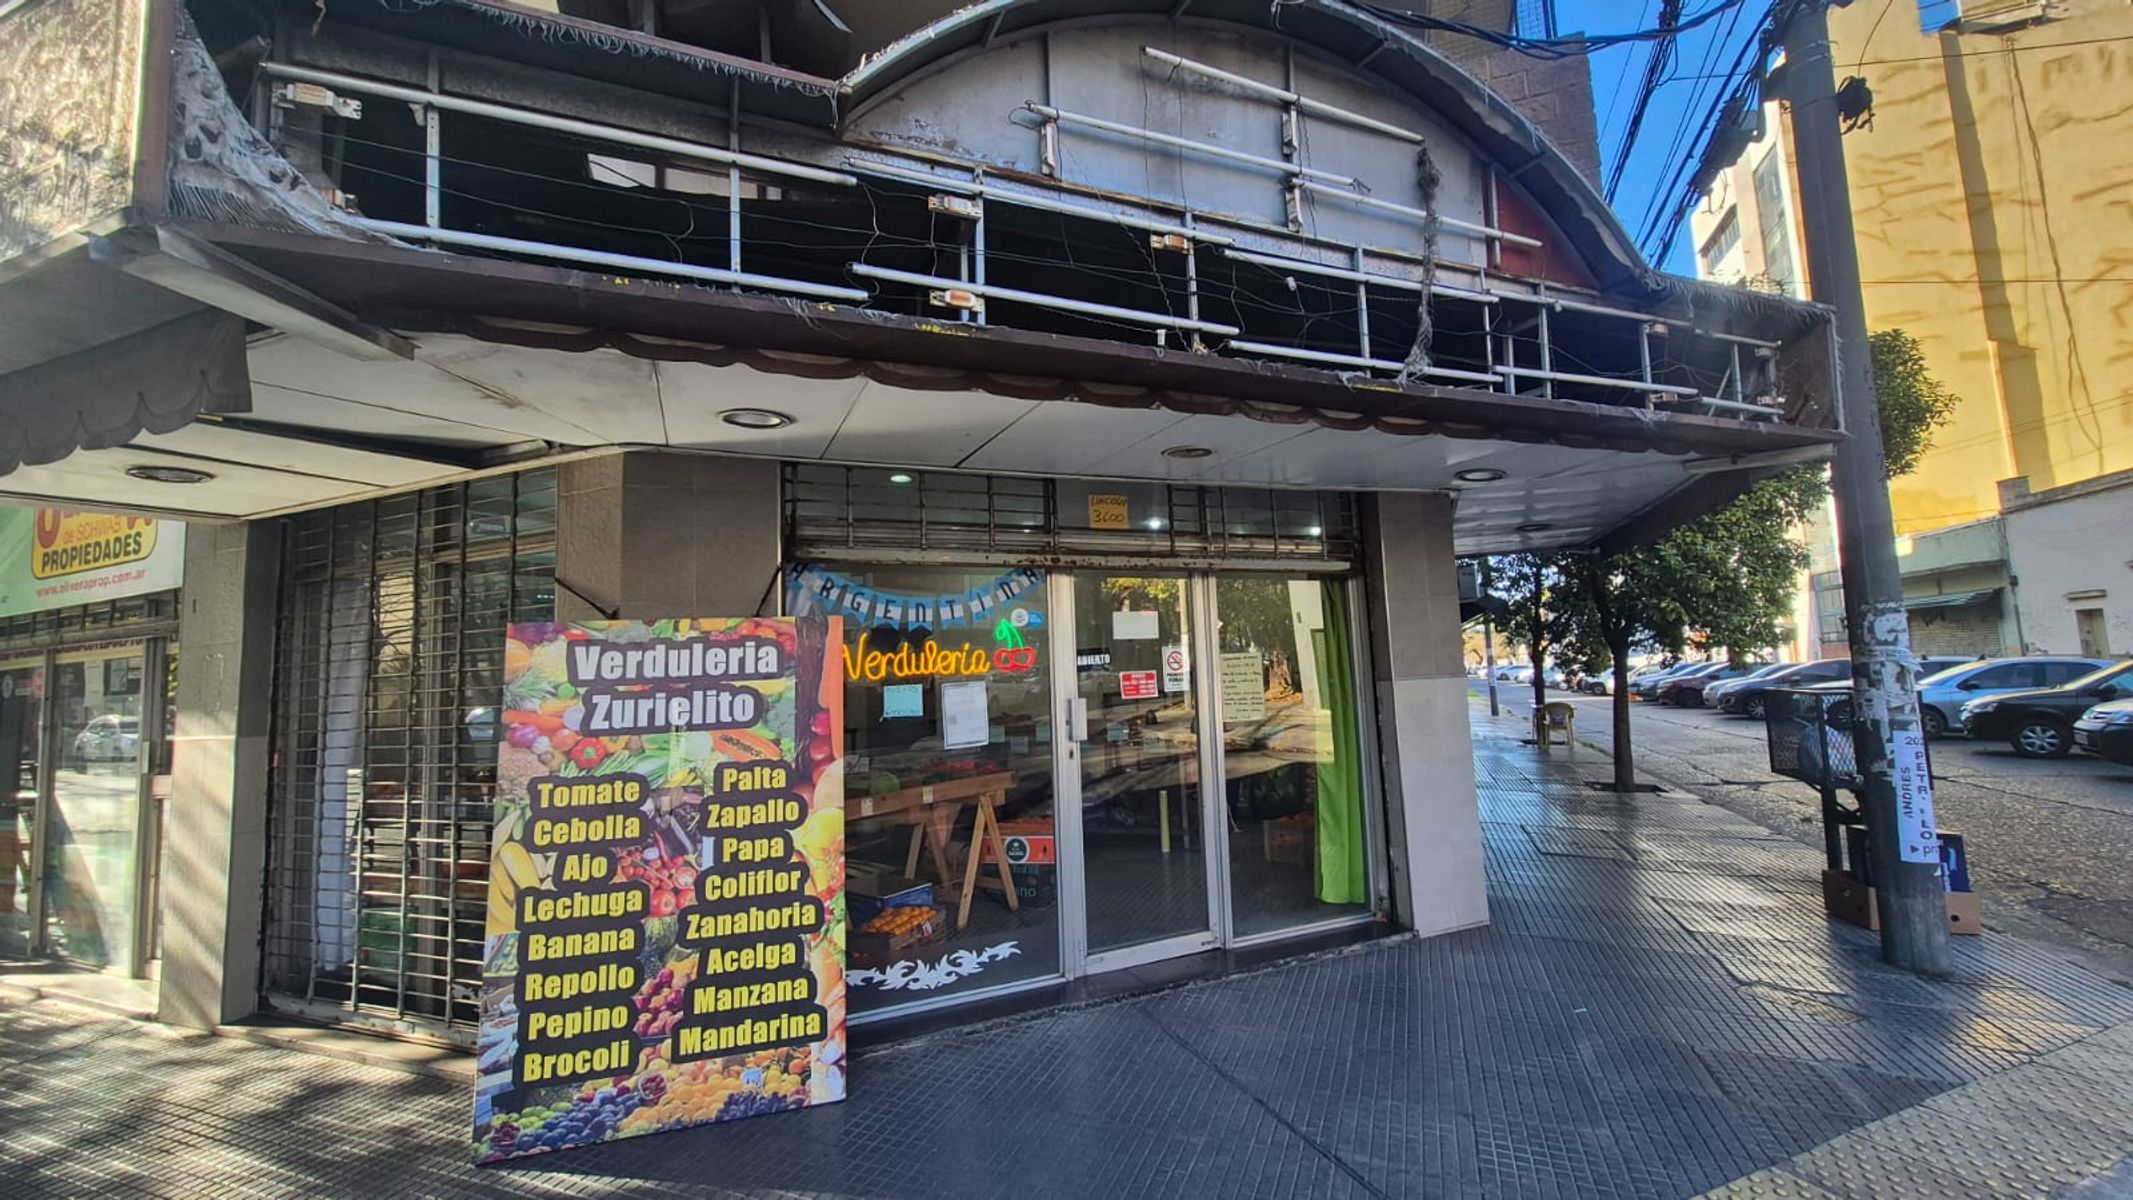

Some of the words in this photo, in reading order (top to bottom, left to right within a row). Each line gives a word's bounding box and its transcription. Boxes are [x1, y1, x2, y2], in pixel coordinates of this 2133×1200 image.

[41, 531, 143, 574] PROPIEDADES
[36, 569, 147, 598] www.oliveraprop.com.ar
[574, 641, 779, 681] Verduleria
[843, 632, 991, 681] Verduleria
[589, 690, 755, 731] Zurielito
[537, 779, 641, 809] Tomate
[722, 767, 787, 792] Palta
[1901, 767, 1914, 819] ANDRES
[533, 816, 641, 847] Cebolla
[706, 799, 801, 829] Zapallo
[722, 836, 785, 863] Papa
[562, 855, 608, 883] Ajo
[705, 869, 802, 901] Coliflor
[523, 889, 643, 924] Lechuga
[686, 903, 817, 940] Zanahoria
[527, 927, 635, 962] Banana
[706, 942, 797, 975] Acelga
[525, 965, 635, 1002] Repollo
[693, 978, 809, 1014] Manzana
[528, 1005, 629, 1041] Pepino
[679, 1012, 821, 1056] Mandarina
[523, 1041, 630, 1083] Brocoli
